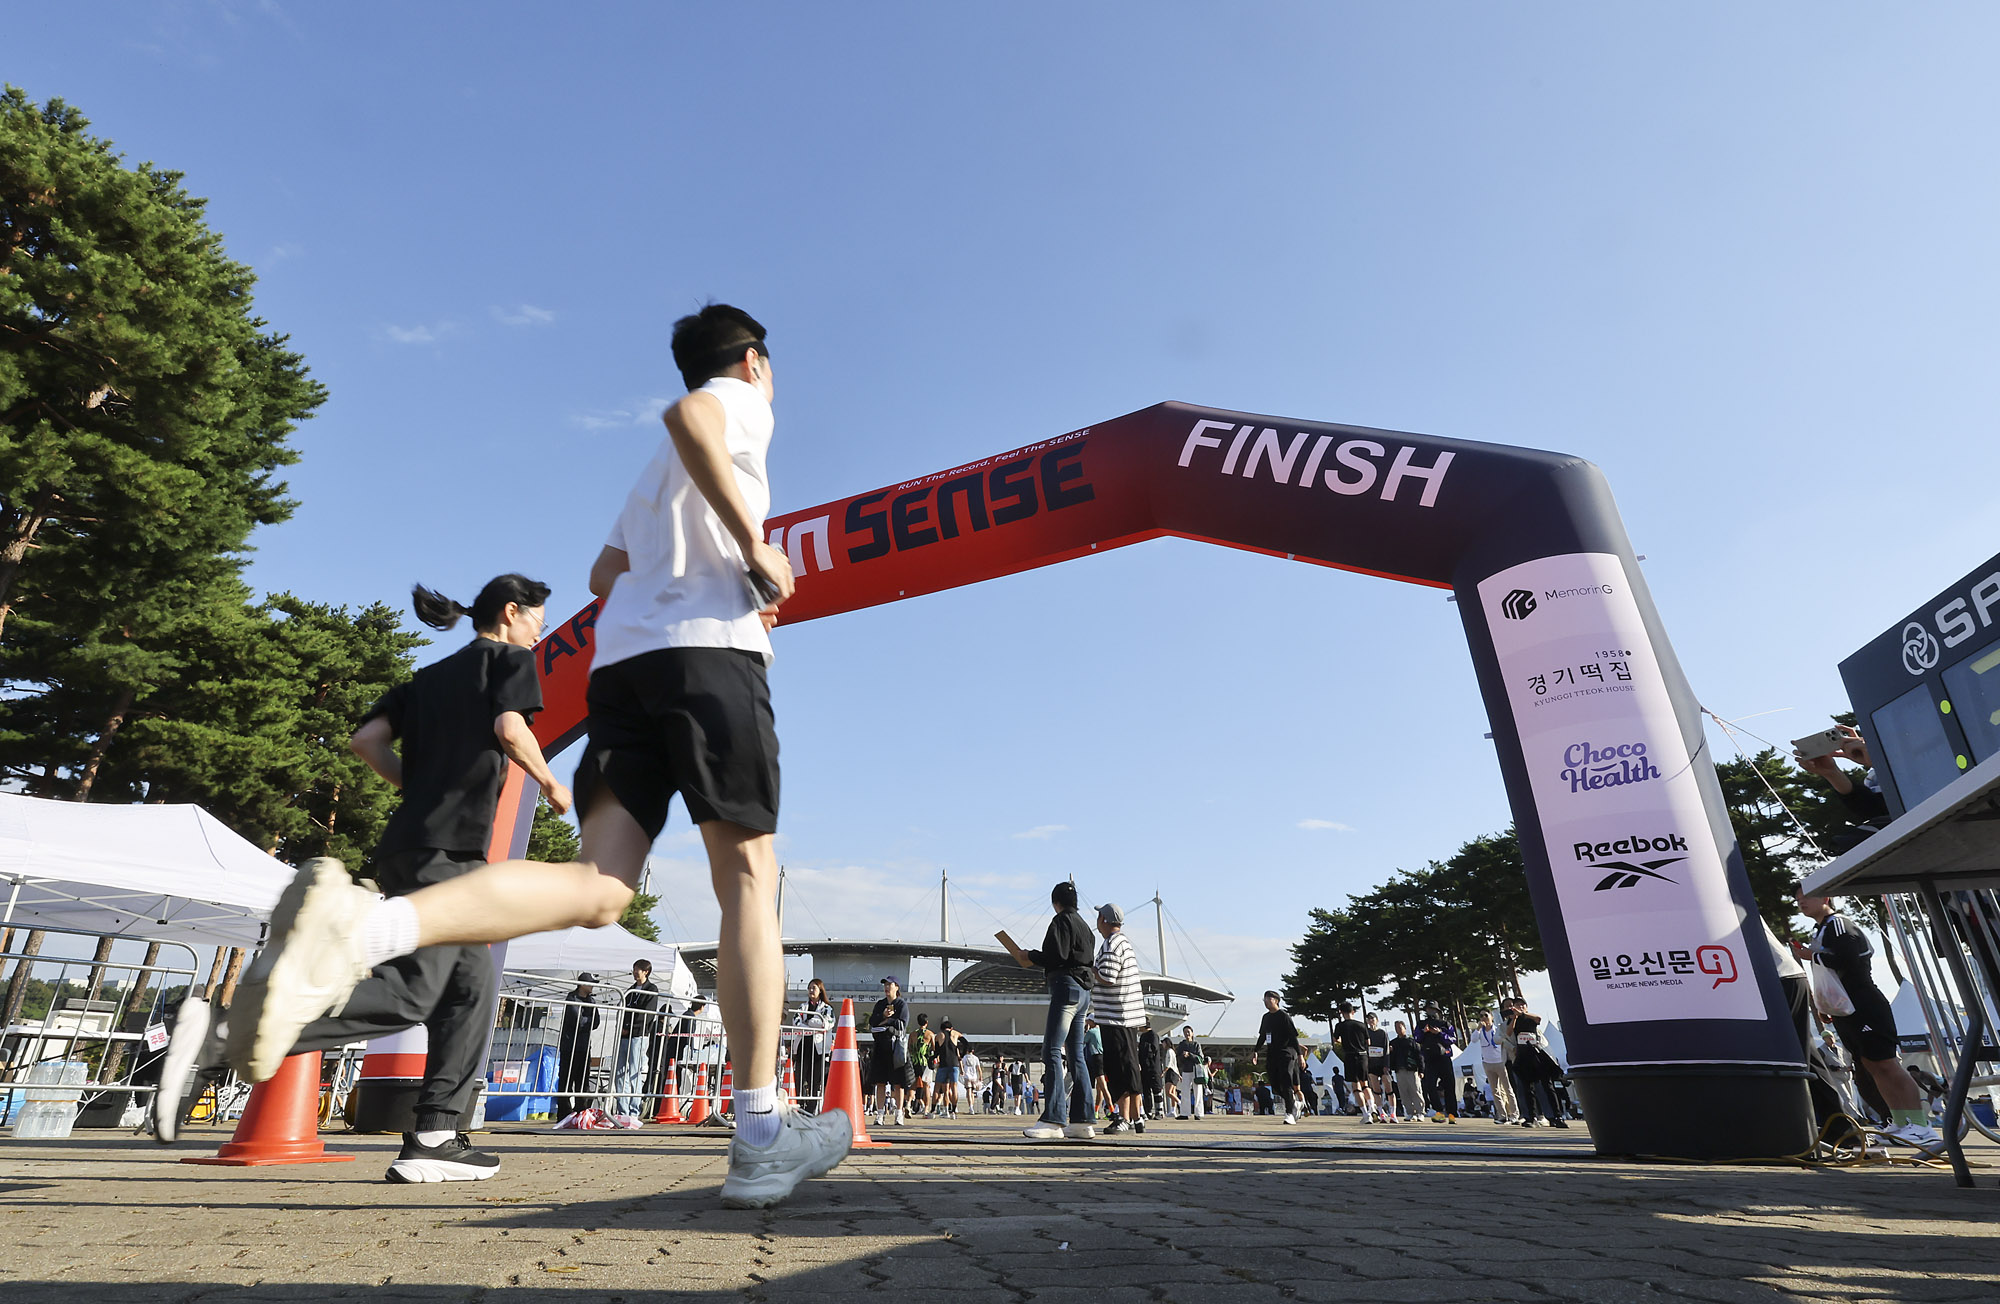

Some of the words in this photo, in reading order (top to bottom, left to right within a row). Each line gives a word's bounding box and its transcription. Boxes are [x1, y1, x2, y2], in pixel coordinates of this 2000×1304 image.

[898, 479, 922, 491] RUN
[925, 473, 945, 483] The
[948, 460, 990, 477] Record.
[995, 450, 1020, 463] Feel
[1023, 443, 1046, 454] The
[1048, 428, 1091, 447] SENSE
[1177, 419, 1457, 508] FINISH
[1545, 584, 1613, 601] MemorinG
[1595, 649, 1624, 659] 1958
[1534, 692, 1573, 708] KYUNGGI
[1574, 687, 1605, 697] TTEOK
[1605, 685, 1636, 693] HOUSE
[1563, 741, 1647, 768] Choco
[1560, 756, 1662, 793] Health
[1573, 833, 1689, 862] Reebok
[1589, 950, 1695, 981] 일요신문
[1607, 981, 1637, 990] REALTIME
[1639, 979, 1658, 987] NEWS
[1660, 978, 1684, 986] MEDIA
